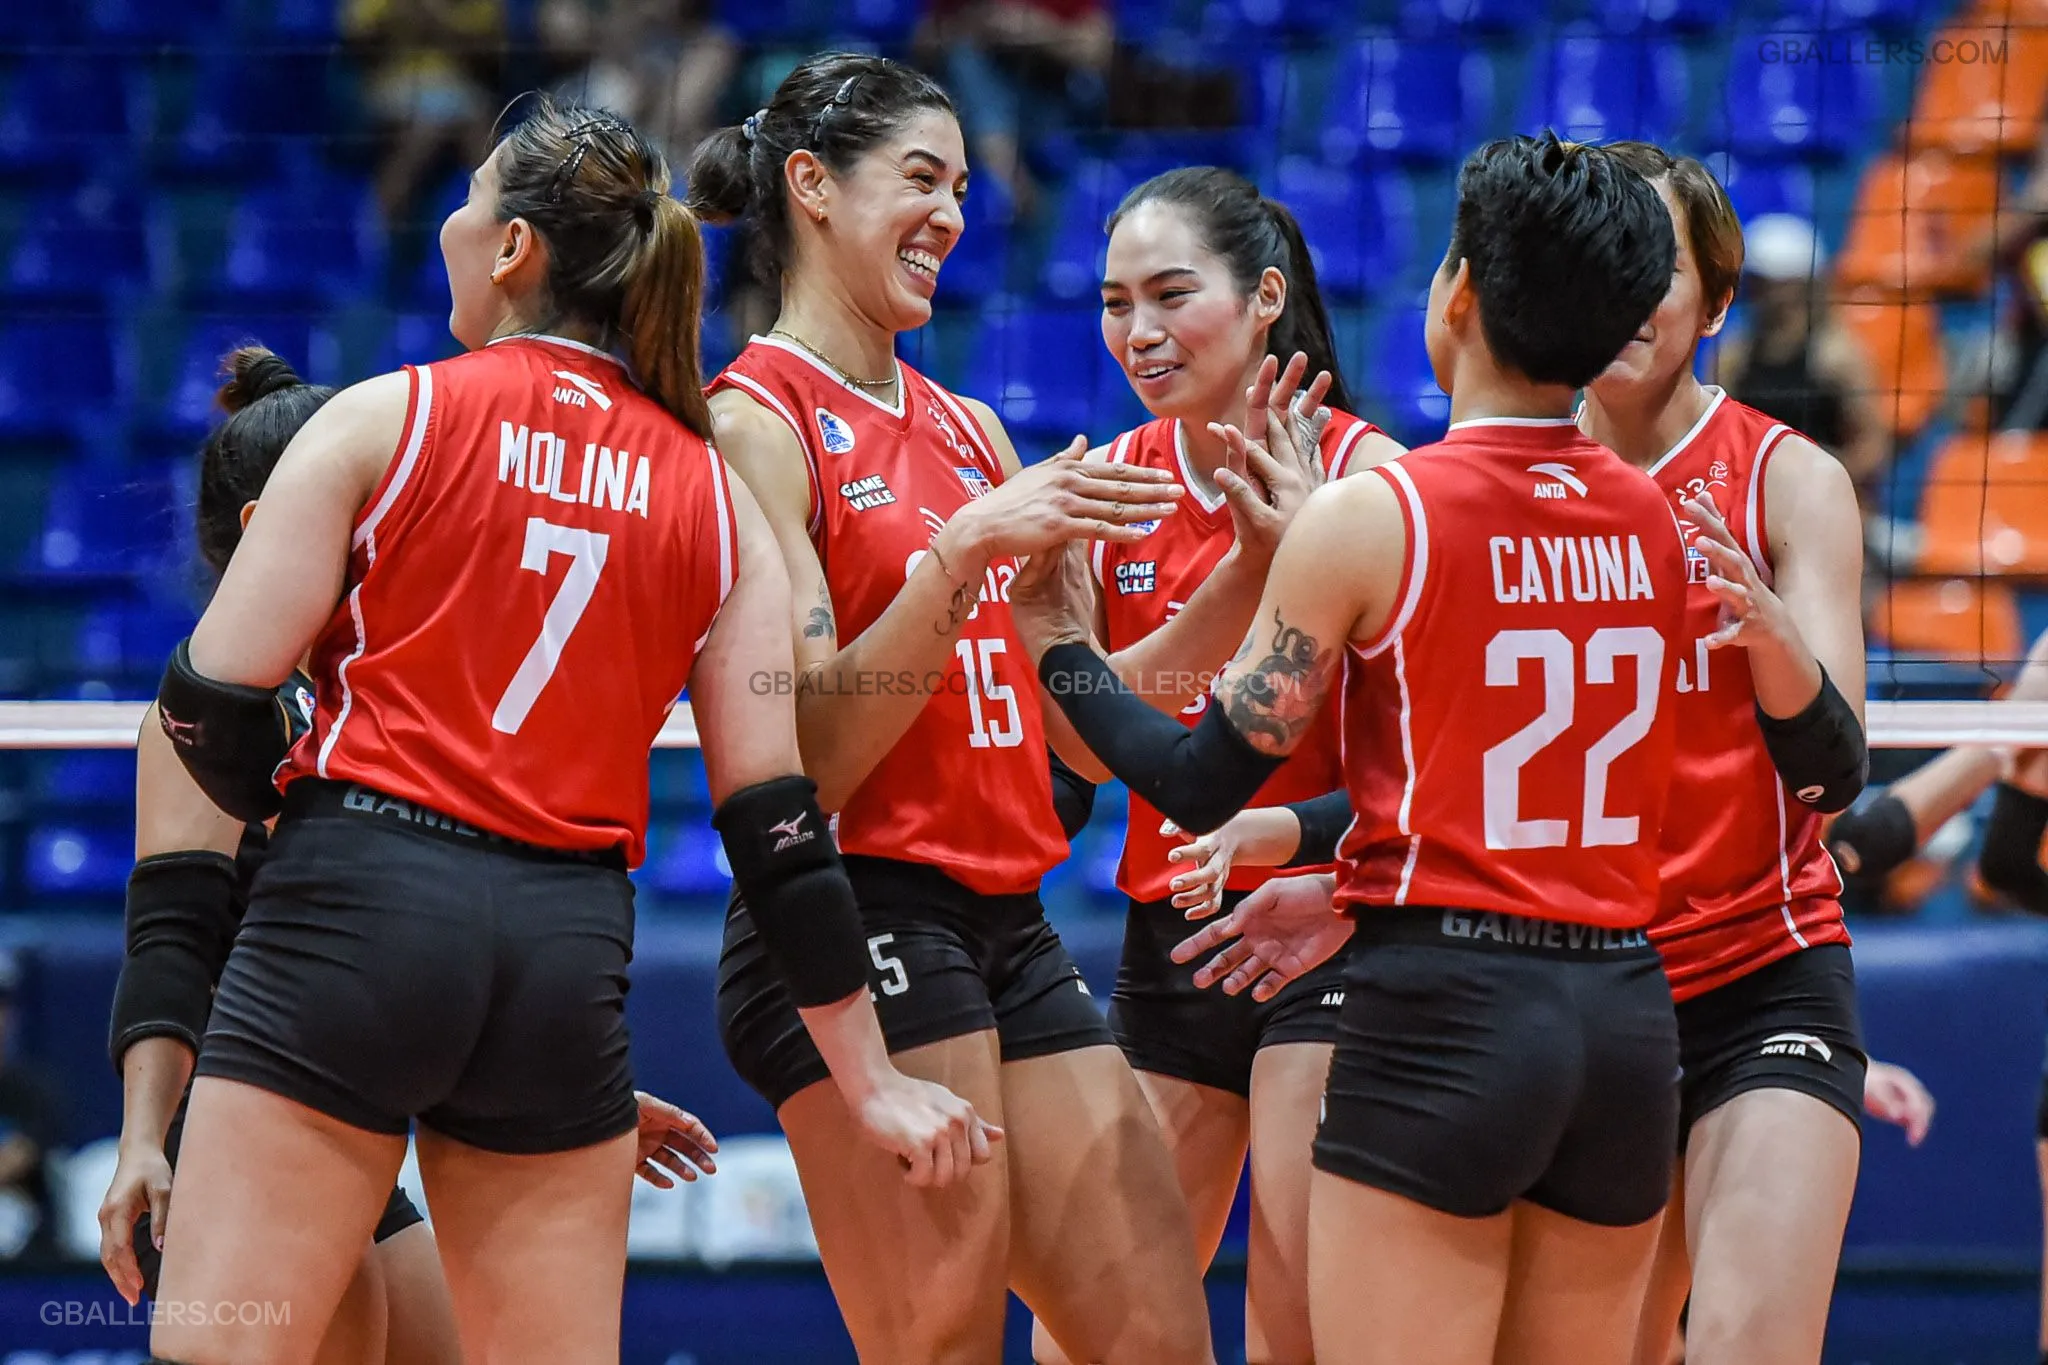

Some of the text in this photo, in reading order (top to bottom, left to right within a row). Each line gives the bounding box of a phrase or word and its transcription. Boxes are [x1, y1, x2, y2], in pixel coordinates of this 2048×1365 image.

[552, 386, 586, 408] ANTA
[498, 421, 650, 520] MOLINA
[840, 475, 886, 497] GAME
[849, 490, 897, 511] VILLE
[1533, 483, 1567, 499] ANTA
[1489, 535, 1654, 603] CAYUNA
[492, 517, 610, 735] 7
[956, 638, 1023, 748] 15
[1483, 626, 1665, 850] 22
[867, 933, 909, 1001] 5
[1321, 992, 1345, 1006] AN
